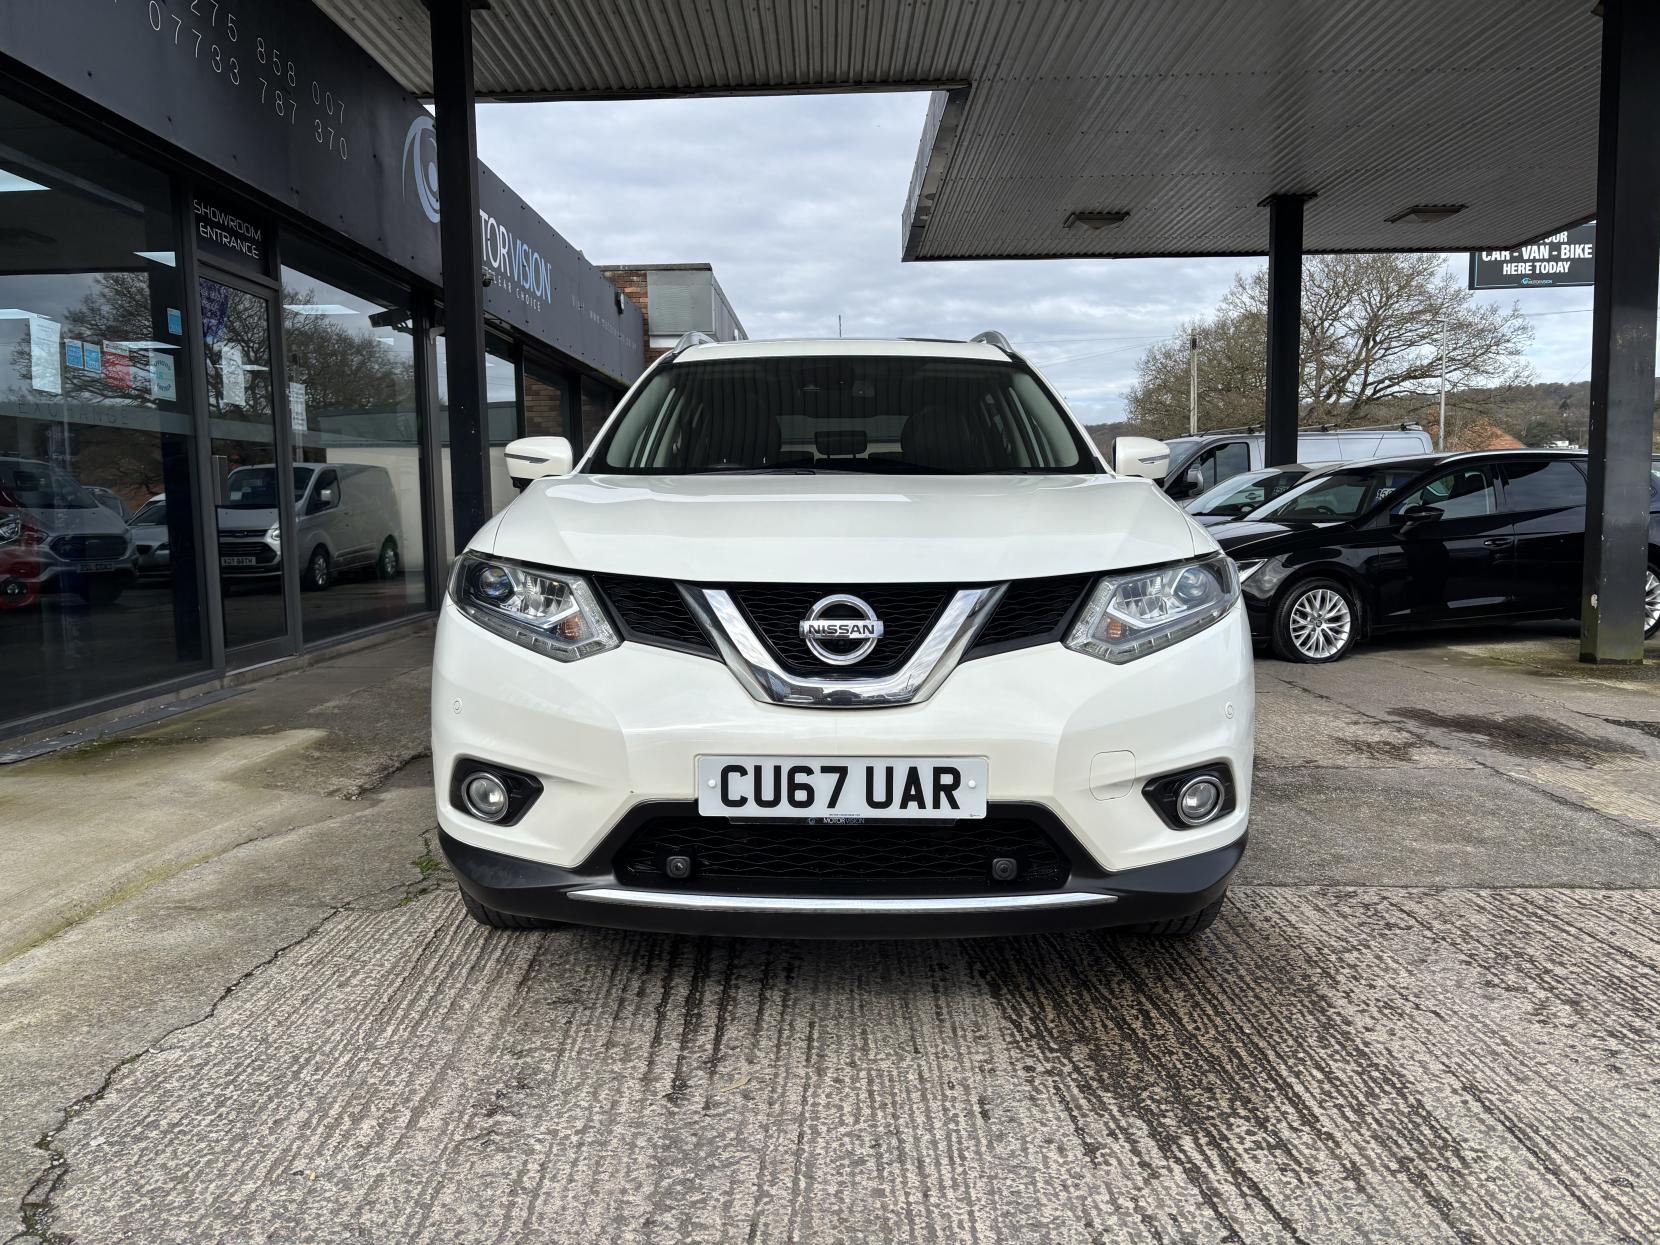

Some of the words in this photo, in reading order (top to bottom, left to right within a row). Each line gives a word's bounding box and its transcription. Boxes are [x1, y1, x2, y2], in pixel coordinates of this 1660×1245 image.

[148, 0, 240, 86] 07733
[258, 78, 297, 125] 787
[314, 119, 348, 160] 370
[257, 37, 296, 87] 858
[311, 81, 345, 125] 007
[193, 199, 262, 242] SHOWROOM
[199, 222, 259, 259] ENTRANCE
[480, 208, 552, 304] TORVISION
[1482, 250, 1511, 261] CAR
[1522, 244, 1549, 259] VAN
[1560, 243, 1593, 258] BIKE
[1503, 262, 1532, 275] HERE
[1535, 262, 1571, 274] TODAY
[492, 273, 512, 294] LEAR
[515, 288, 542, 312] CHOICE
[809, 624, 875, 635] NISSAN
[720, 764, 849, 809] CU67
[865, 765, 962, 810] UAR
